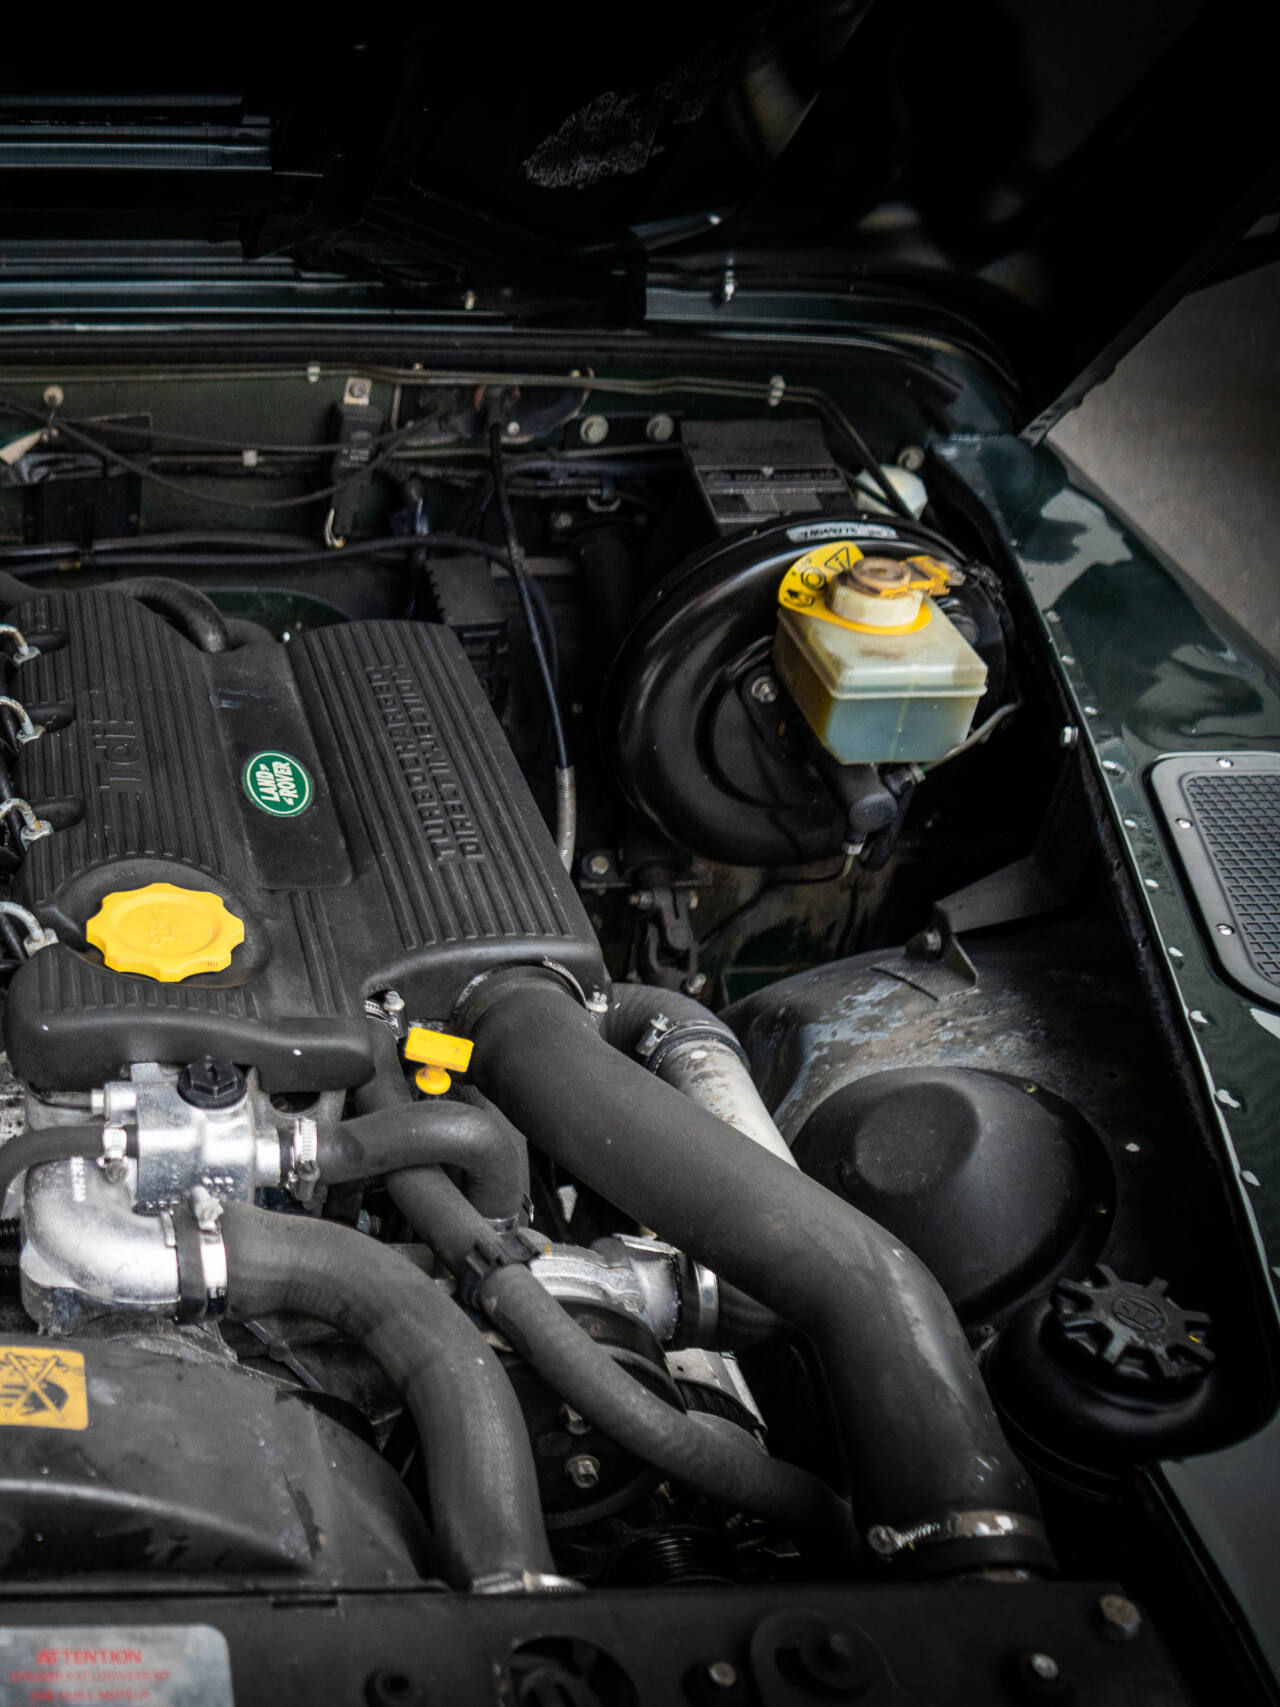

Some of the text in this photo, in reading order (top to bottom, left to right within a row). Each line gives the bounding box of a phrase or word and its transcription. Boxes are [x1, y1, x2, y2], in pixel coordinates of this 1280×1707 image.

[255, 770, 280, 802] LAND
[271, 761, 299, 799] ROVER
[37, 1649, 142, 1665] ATTENTION
